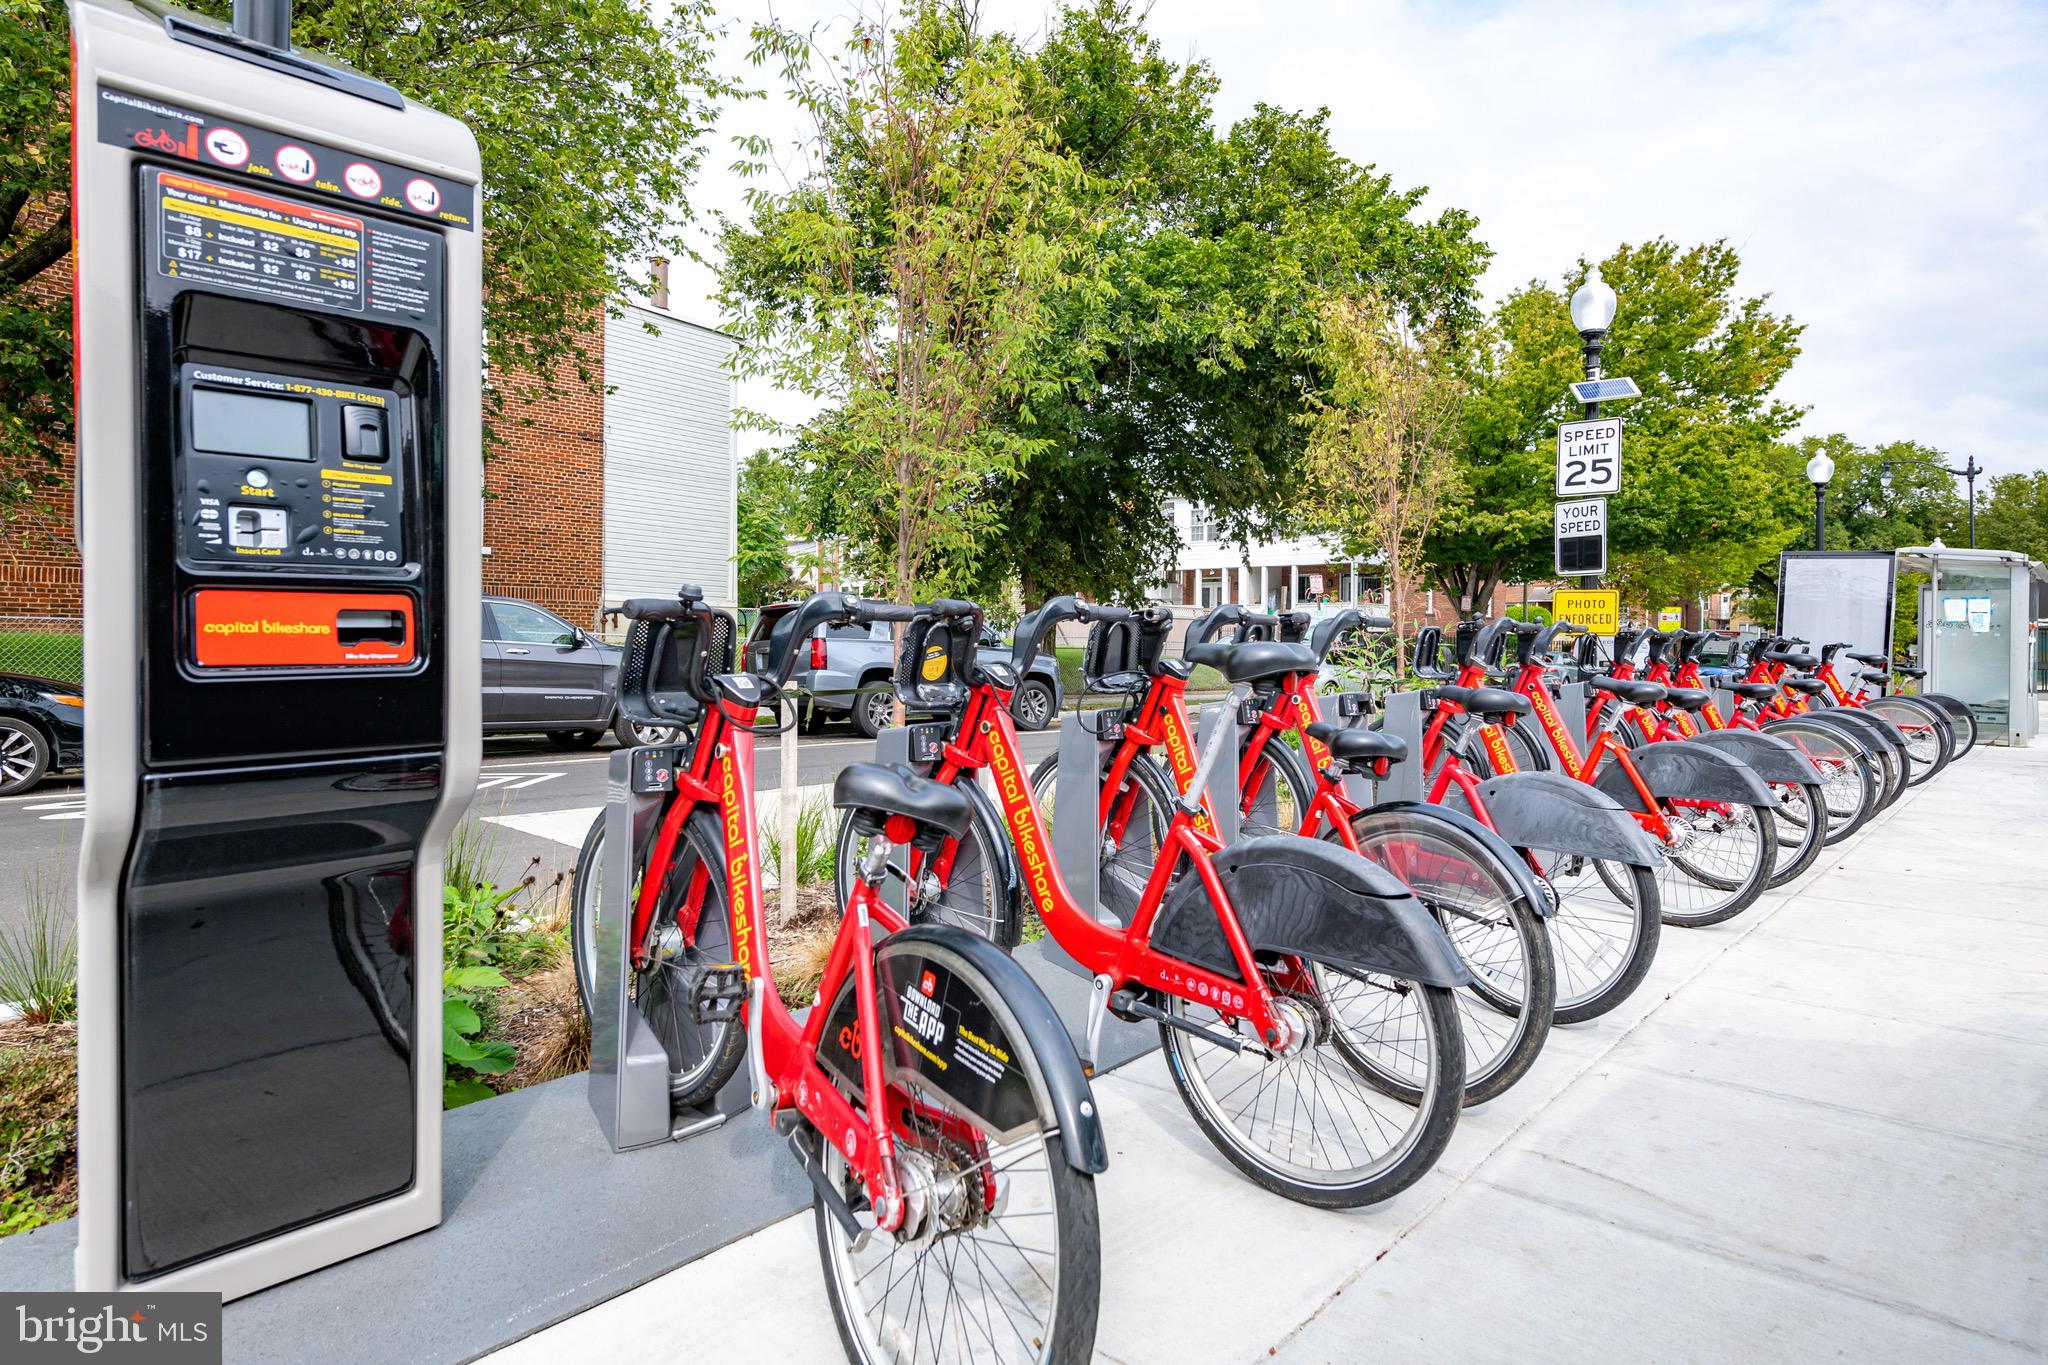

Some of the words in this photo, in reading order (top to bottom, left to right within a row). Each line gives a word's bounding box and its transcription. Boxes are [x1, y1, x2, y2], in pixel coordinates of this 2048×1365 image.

[102, 91, 204, 124] CapitalBikeshare.com
[246, 162, 273, 177] join.
[315, 178, 341, 194] take.
[380, 195, 403, 209] ride.
[439, 210, 470, 225] return.
[166, 188, 187, 198] Your
[188, 192, 208, 204] cost
[218, 198, 268, 218] Membership
[269, 212, 282, 221] fee
[292, 216, 318, 229] Usage
[319, 222, 330, 232] fee
[331, 226, 343, 236] per
[344, 229, 357, 238] trip
[184, 225, 202, 237] $8
[218, 233, 255, 247] Included
[263, 240, 279, 252] $2
[178, 247, 202, 260] $17
[295, 247, 310, 259] $6
[218, 256, 255, 271] Included
[263, 263, 280, 276] $2
[295, 270, 311, 282] $6
[193, 370, 242, 384] Customer
[244, 377, 284, 390] Service:
[285, 383, 356, 400] 1-877-430-BIKE
[1564, 427, 1616, 443] SPEED
[1569, 443, 1609, 457] LIMIT
[1565, 458, 1612, 486] 25
[240, 486, 275, 497] Start
[200, 498, 220, 506] VISA
[1563, 505, 1598, 519] YOUR
[1560, 520, 1601, 534] SPEED
[236, 547, 260, 555] Insert
[1568, 600, 1605, 610] PHOTO
[204, 622, 258, 636] capital
[262, 620, 330, 634] bikeshare
[1532, 691, 1556, 728] capital
[1552, 727, 1581, 779] bikeshare
[1164, 714, 1192, 774] capital
[722, 756, 744, 849] capital
[989, 730, 1024, 803] capital
[1013, 805, 1054, 913] bikeshare
[906, 985, 941, 1018] DOWNLOAD
[900, 995, 919, 1030] THE
[918, 1010, 945, 1046] APP
[959, 1024, 968, 1038] The
[968, 1030, 979, 1045] Best
[978, 1037, 990, 1052] Way
[990, 1044, 996, 1055] To
[996, 1048, 1009, 1063] Ride
